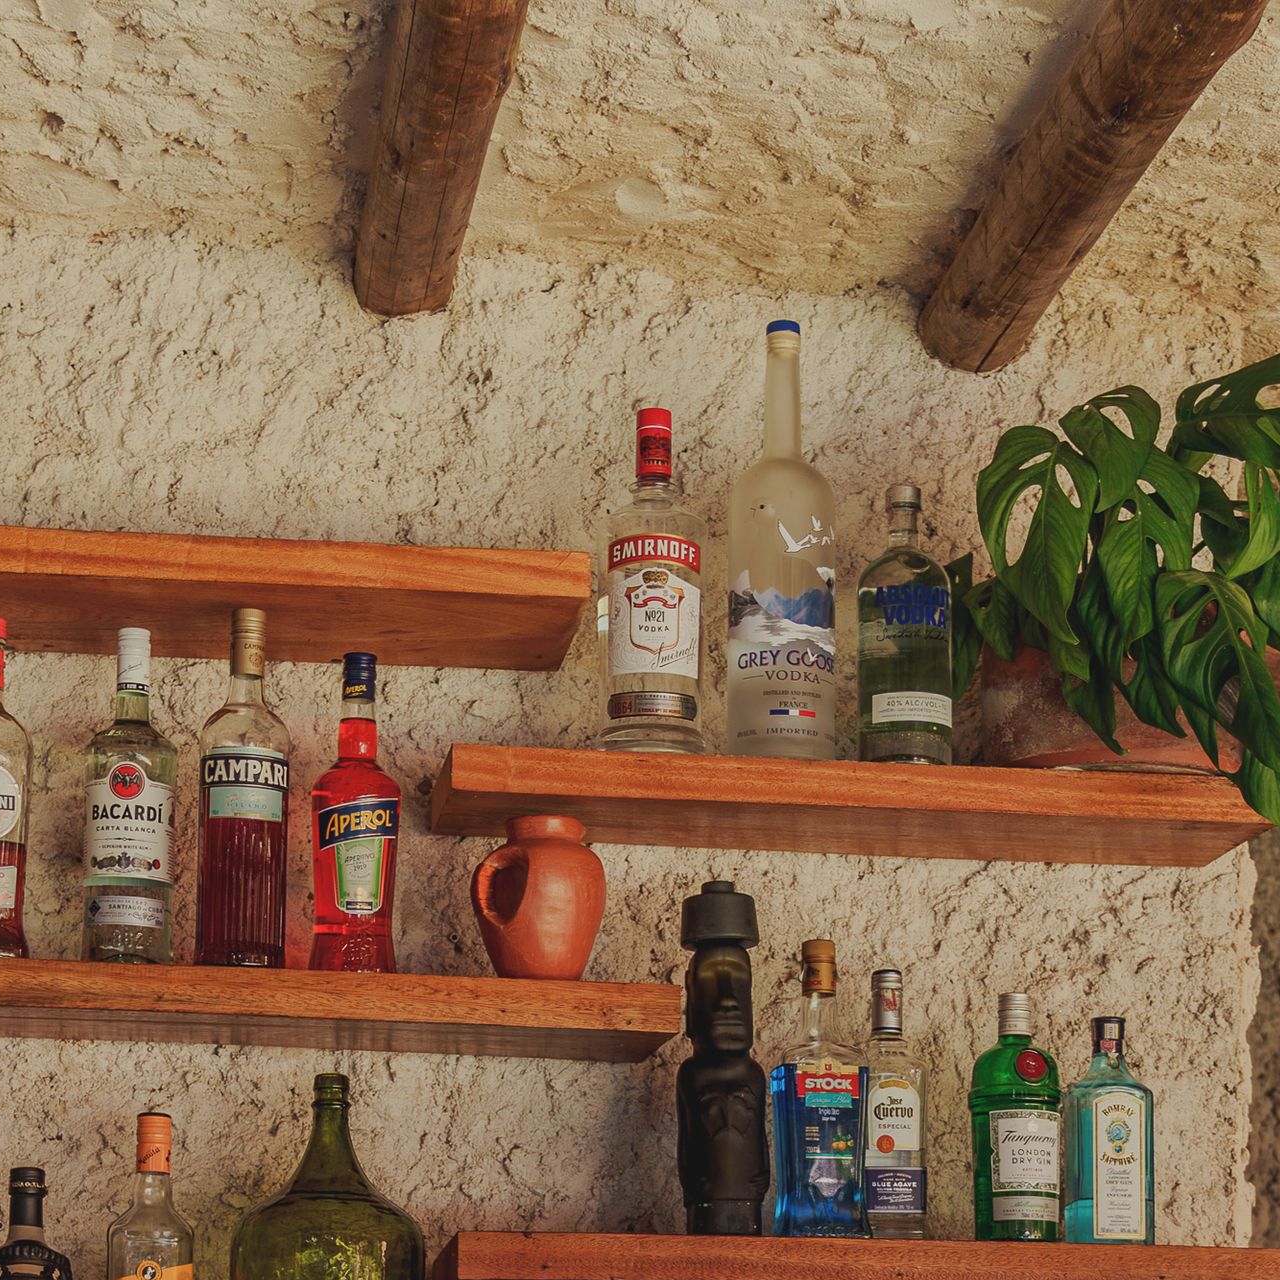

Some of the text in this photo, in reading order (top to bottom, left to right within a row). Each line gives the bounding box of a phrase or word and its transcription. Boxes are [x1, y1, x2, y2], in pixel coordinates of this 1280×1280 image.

[613, 538, 696, 563] SMIRNOFF
[883, 604, 947, 629] VODKA
[638, 624, 670, 633] VODKA
[737, 649, 781, 670] GREY
[765, 669, 820, 684] VODKA
[779, 700, 808, 709] FRANCE
[766, 727, 818, 737] IMPORTED
[205, 759, 287, 788] CAMPARI
[92, 803, 163, 824] BACARDÍ
[123, 826, 156, 834] BLANCA
[326, 809, 392, 840] APEROL
[108, 903, 142, 911] SANTIAGO
[805, 1077, 853, 1091] STOCK
[874, 1102, 914, 1121] Cuervo
[1101, 1104, 1134, 1117] BOMBAY
[1001, 1130, 1057, 1148] Tanqueray
[1011, 1148, 1051, 1157] LONDON
[1100, 1151, 1138, 1166] SAPPHIRE
